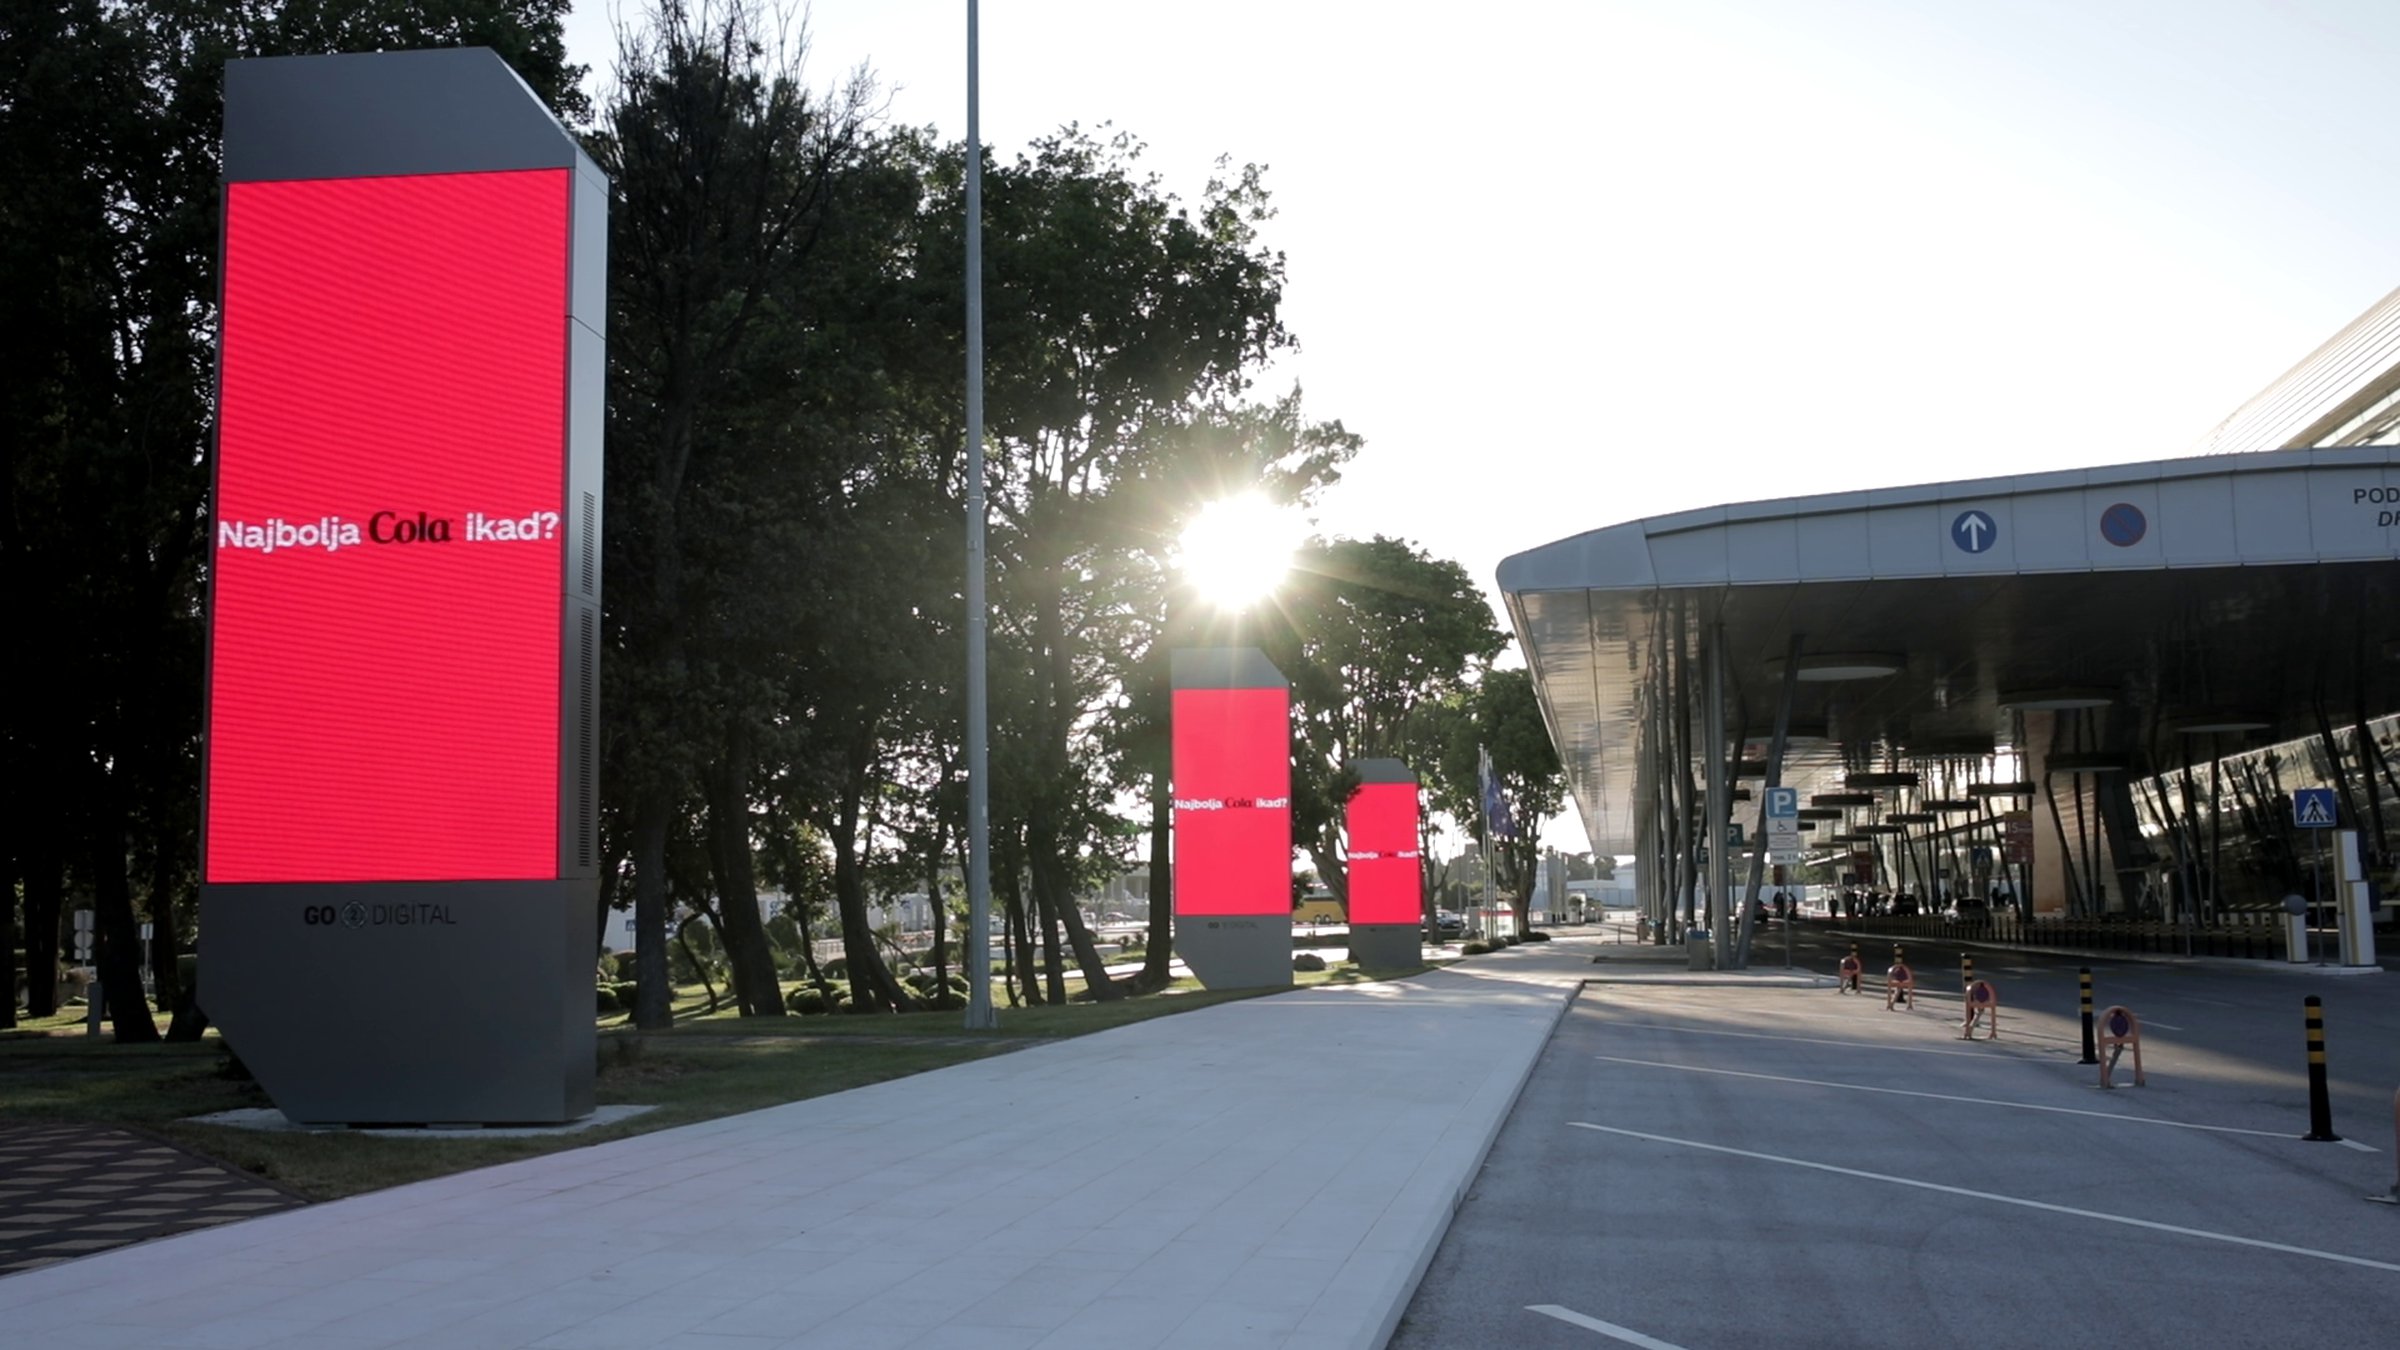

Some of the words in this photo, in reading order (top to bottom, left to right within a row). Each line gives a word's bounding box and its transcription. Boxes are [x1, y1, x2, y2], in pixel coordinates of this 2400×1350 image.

[218, 516, 361, 553] Najbolja
[368, 511, 452, 544] Cola
[466, 511, 560, 542] ikad?
[1174, 798, 1223, 811] Najbolja
[1224, 797, 1253, 808] Cola
[1256, 797, 1288, 808] ikad?
[1773, 791, 1792, 814] P
[304, 905, 336, 925] GO
[372, 903, 457, 926] DIGITAL
